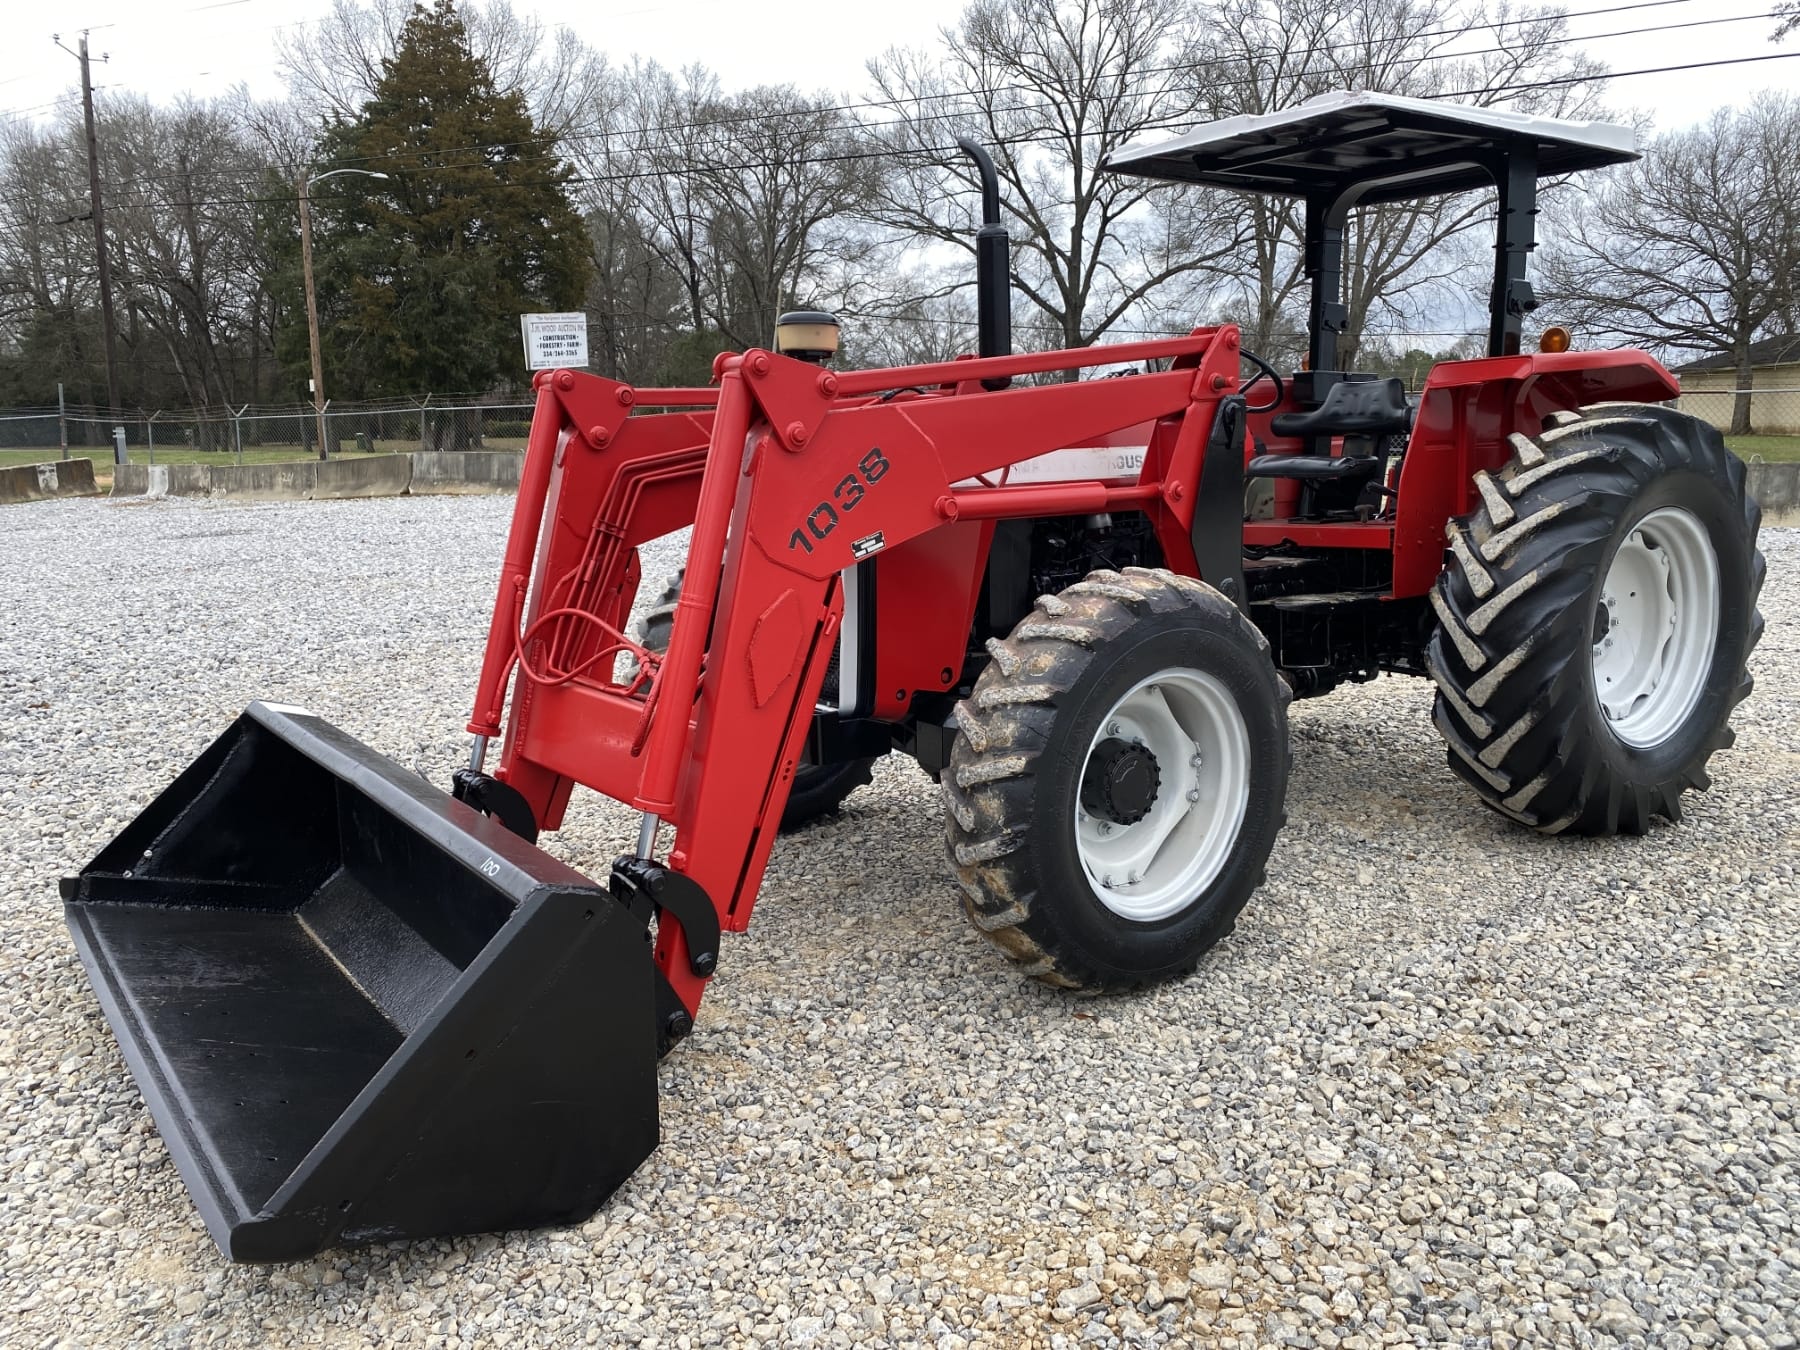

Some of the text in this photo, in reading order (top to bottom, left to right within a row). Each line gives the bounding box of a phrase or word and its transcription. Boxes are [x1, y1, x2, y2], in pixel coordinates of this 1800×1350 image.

[557, 324, 576, 332] AUCTION
[789, 448, 890, 555] 1038
[480, 857, 500, 876] 100
